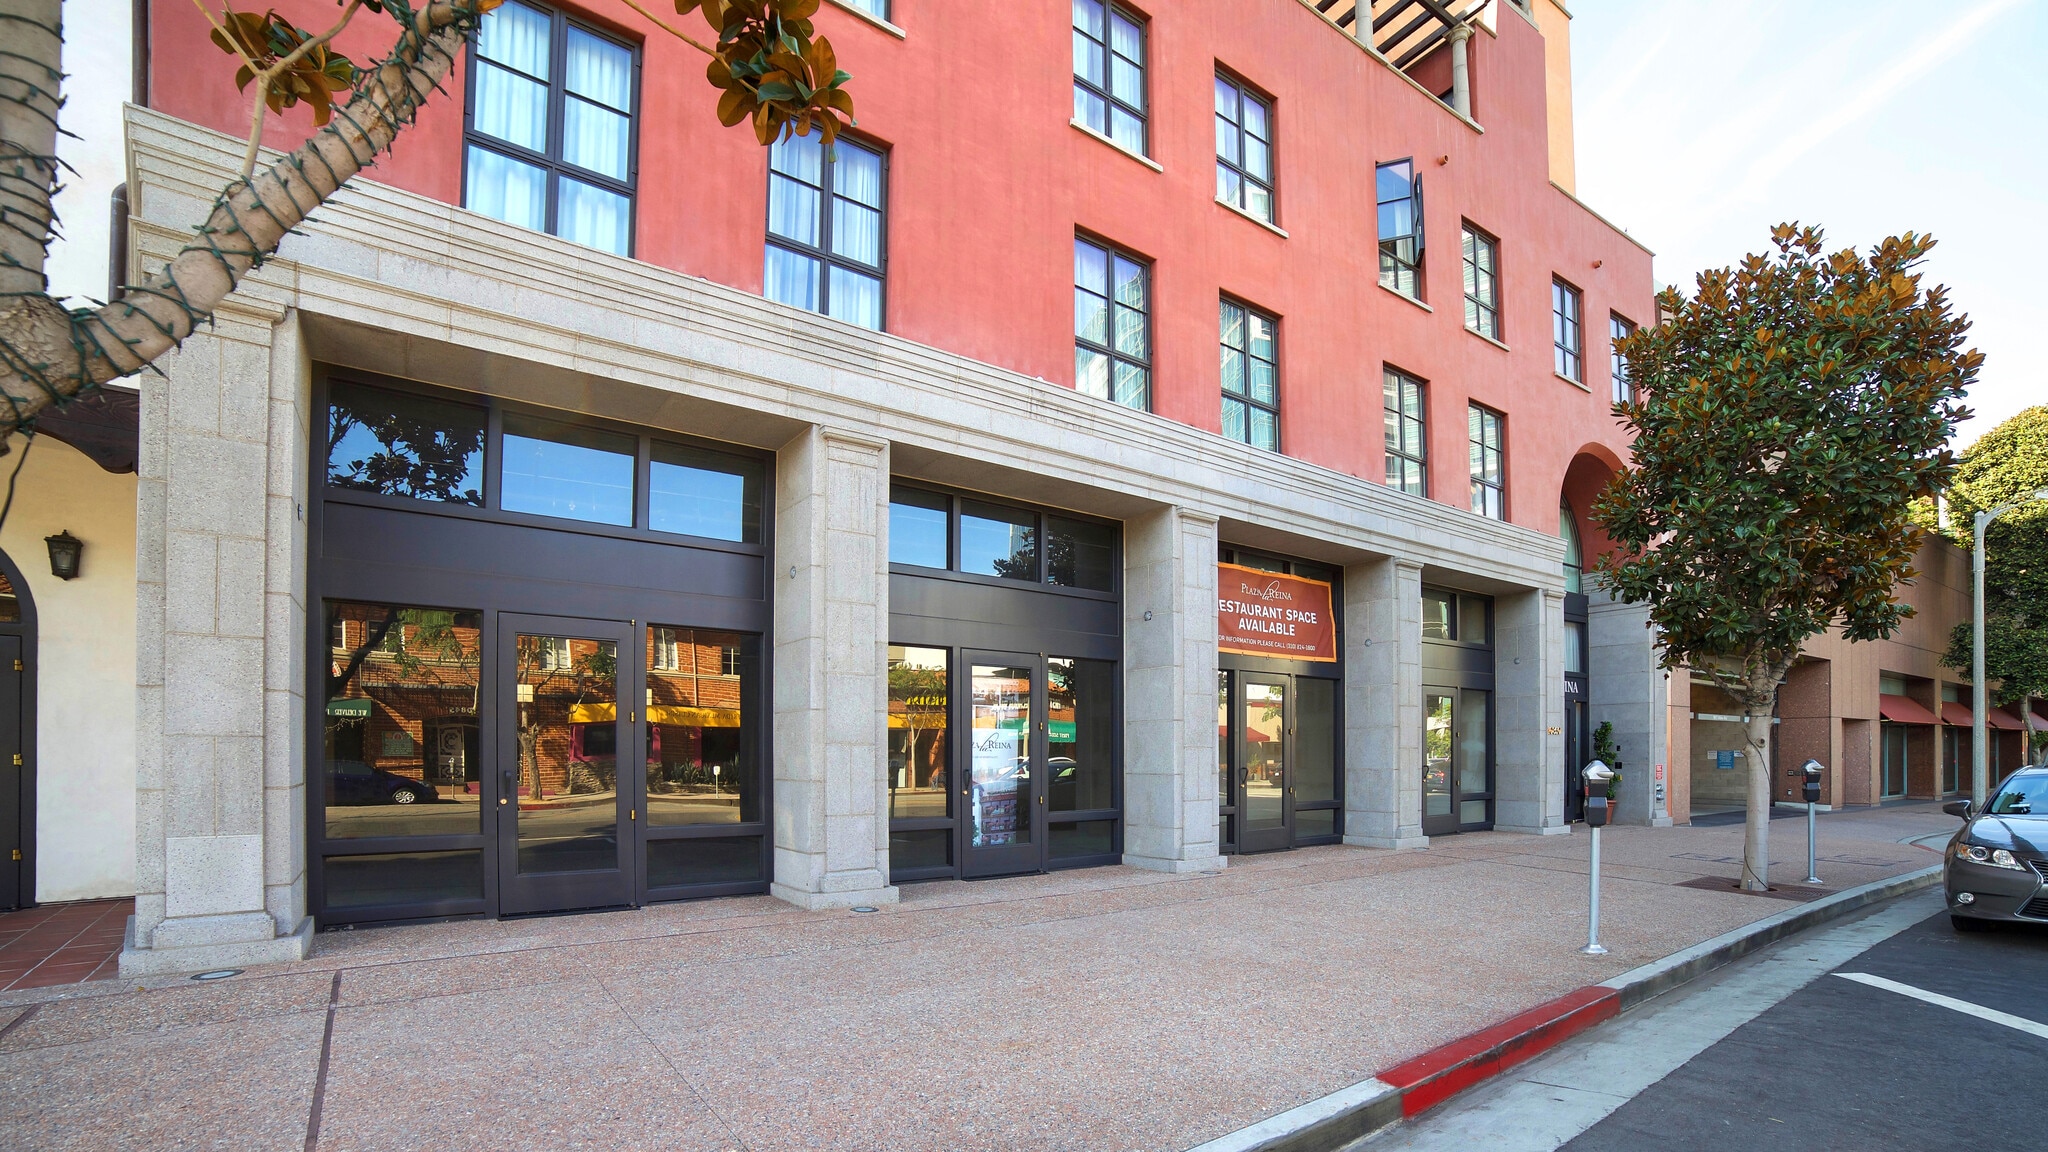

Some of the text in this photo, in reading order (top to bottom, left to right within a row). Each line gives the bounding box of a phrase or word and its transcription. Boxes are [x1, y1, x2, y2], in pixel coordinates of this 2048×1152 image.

[1241, 583, 1262, 597] PLAZA
[1269, 588, 1292, 600] REINA
[1218, 599, 1318, 624] ESTAURANT SPACE
[1238, 617, 1296, 636] AVAILABLE
[1225, 635, 1257, 645] INFORMATION
[1257, 639, 1274, 647] PLEASE
[1274, 641, 1286, 649] CALL
[1564, 680, 1579, 693] INA
